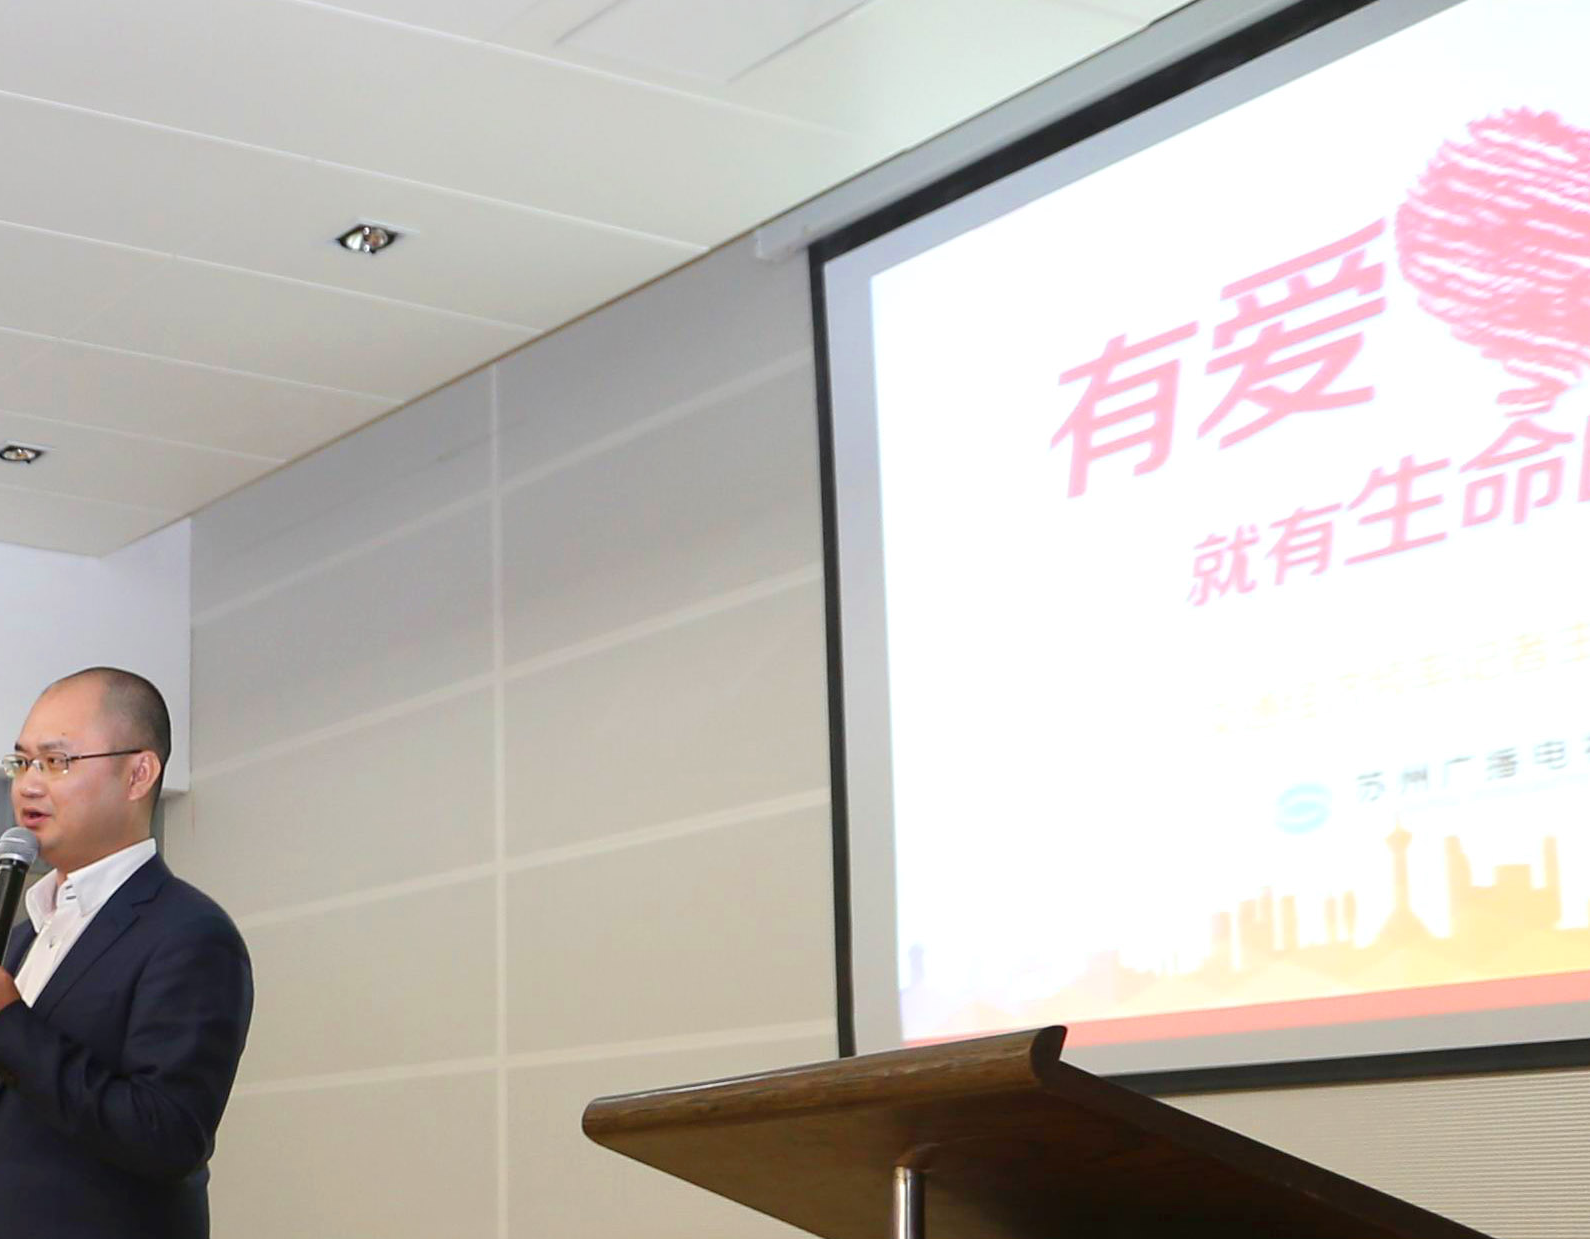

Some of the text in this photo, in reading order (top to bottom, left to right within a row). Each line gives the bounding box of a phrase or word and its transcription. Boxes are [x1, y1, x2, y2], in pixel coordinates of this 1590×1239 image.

[1050, 216, 1387, 498] 有爱
[1187, 415, 1590, 607] 就有生命
[1355, 732, 1590, 803] 苏州广播电
